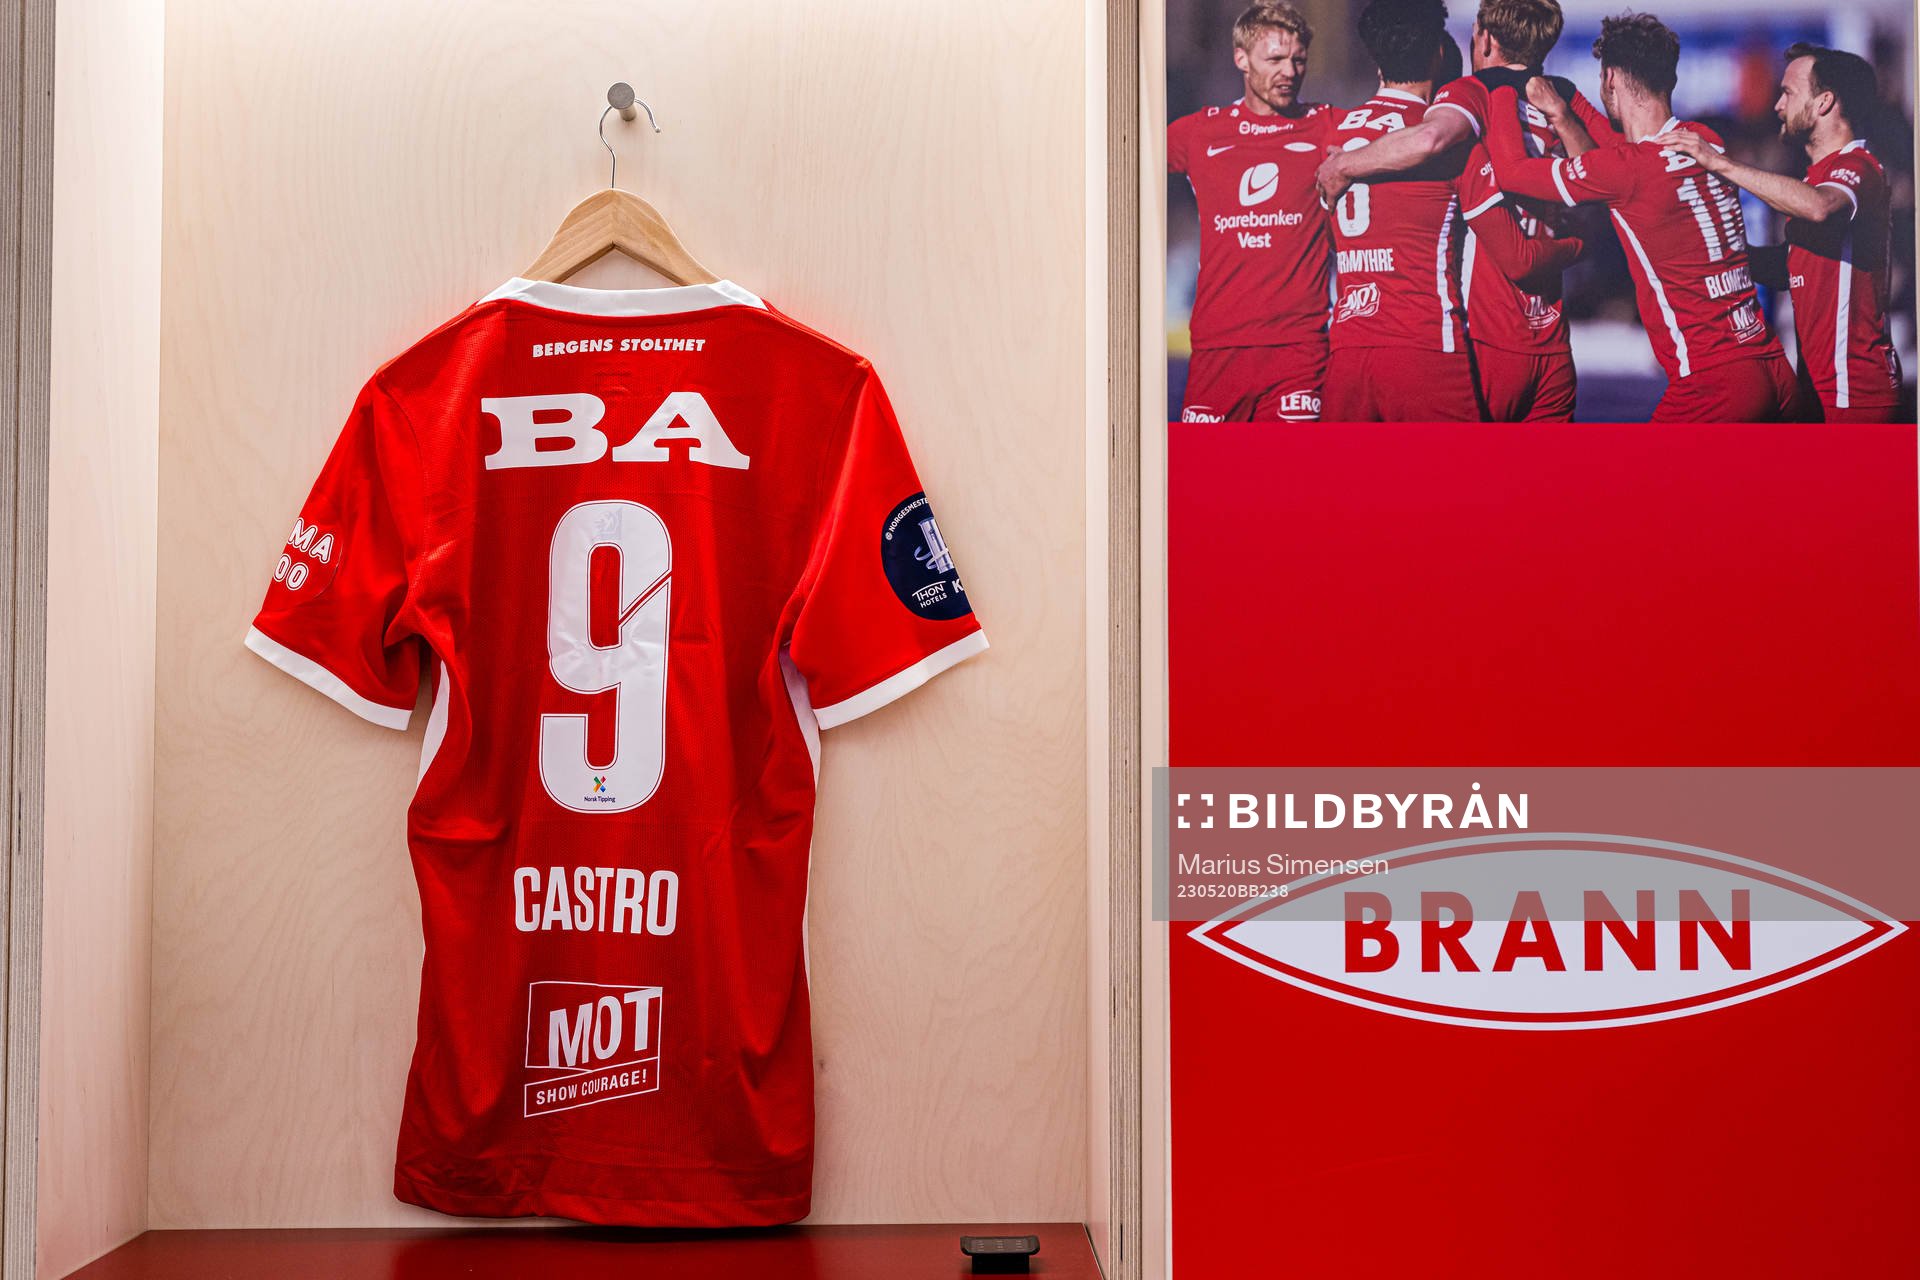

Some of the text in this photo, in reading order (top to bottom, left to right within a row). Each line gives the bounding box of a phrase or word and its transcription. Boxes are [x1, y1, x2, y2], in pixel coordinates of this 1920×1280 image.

[1337, 109, 1406, 133] BA
[1214, 209, 1303, 233] Sparebanken
[1238, 232, 1272, 248] Vest
[533, 338, 706, 358] BERGENS STOLTHET
[481, 392, 750, 470] BA
[912, 581, 946, 602] THON
[920, 592, 948, 609] HOTELS
[539, 499, 673, 814] 9
[513, 866, 679, 936] CASTRO
[1344, 889, 1751, 973] BRANN
[548, 987, 663, 1069] MOT
[536, 1068, 648, 1106] SHOW COURAGE!
